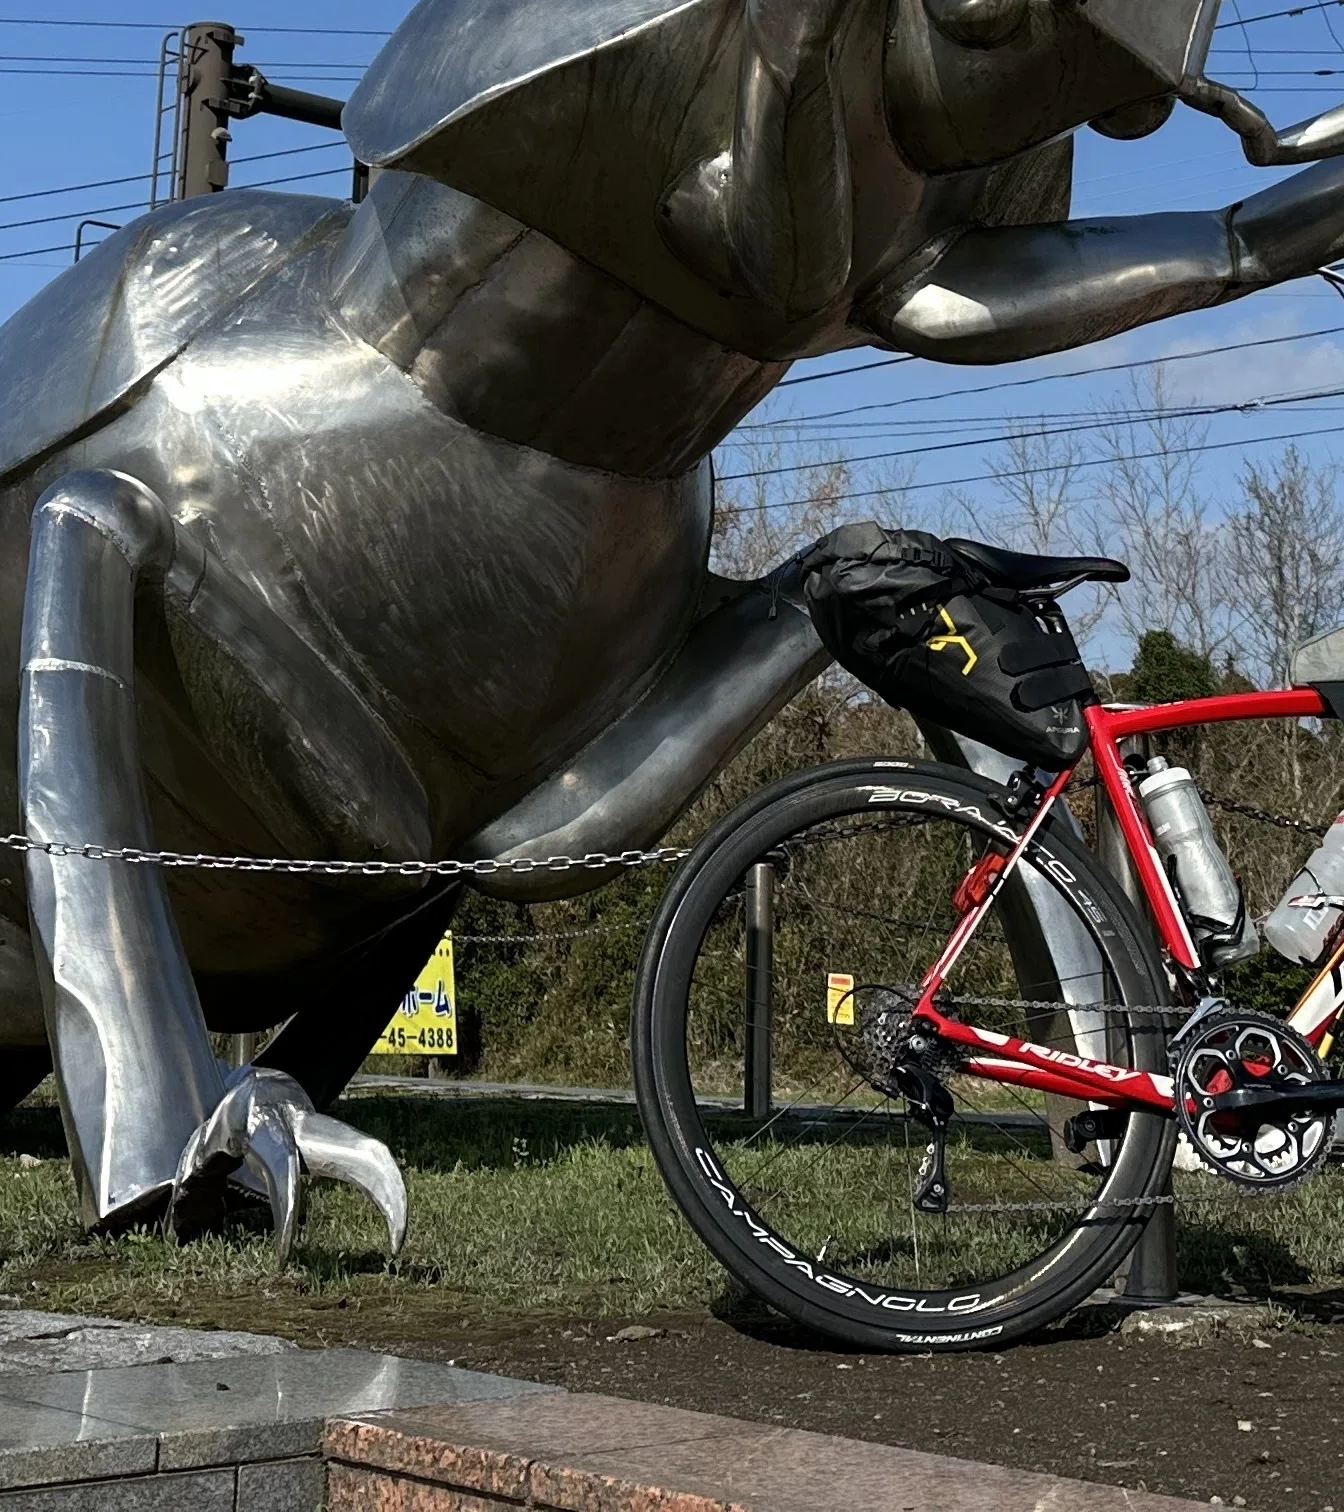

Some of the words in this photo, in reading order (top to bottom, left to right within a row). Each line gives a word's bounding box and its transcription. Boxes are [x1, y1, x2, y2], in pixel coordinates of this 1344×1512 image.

[868, 789, 988, 825] BORA
[1018, 1042, 1142, 1082] RIDLEY
[695, 1147, 981, 1313] CAMPAGNOLO
[895, 1325, 1004, 1345] CONTINENTAL
